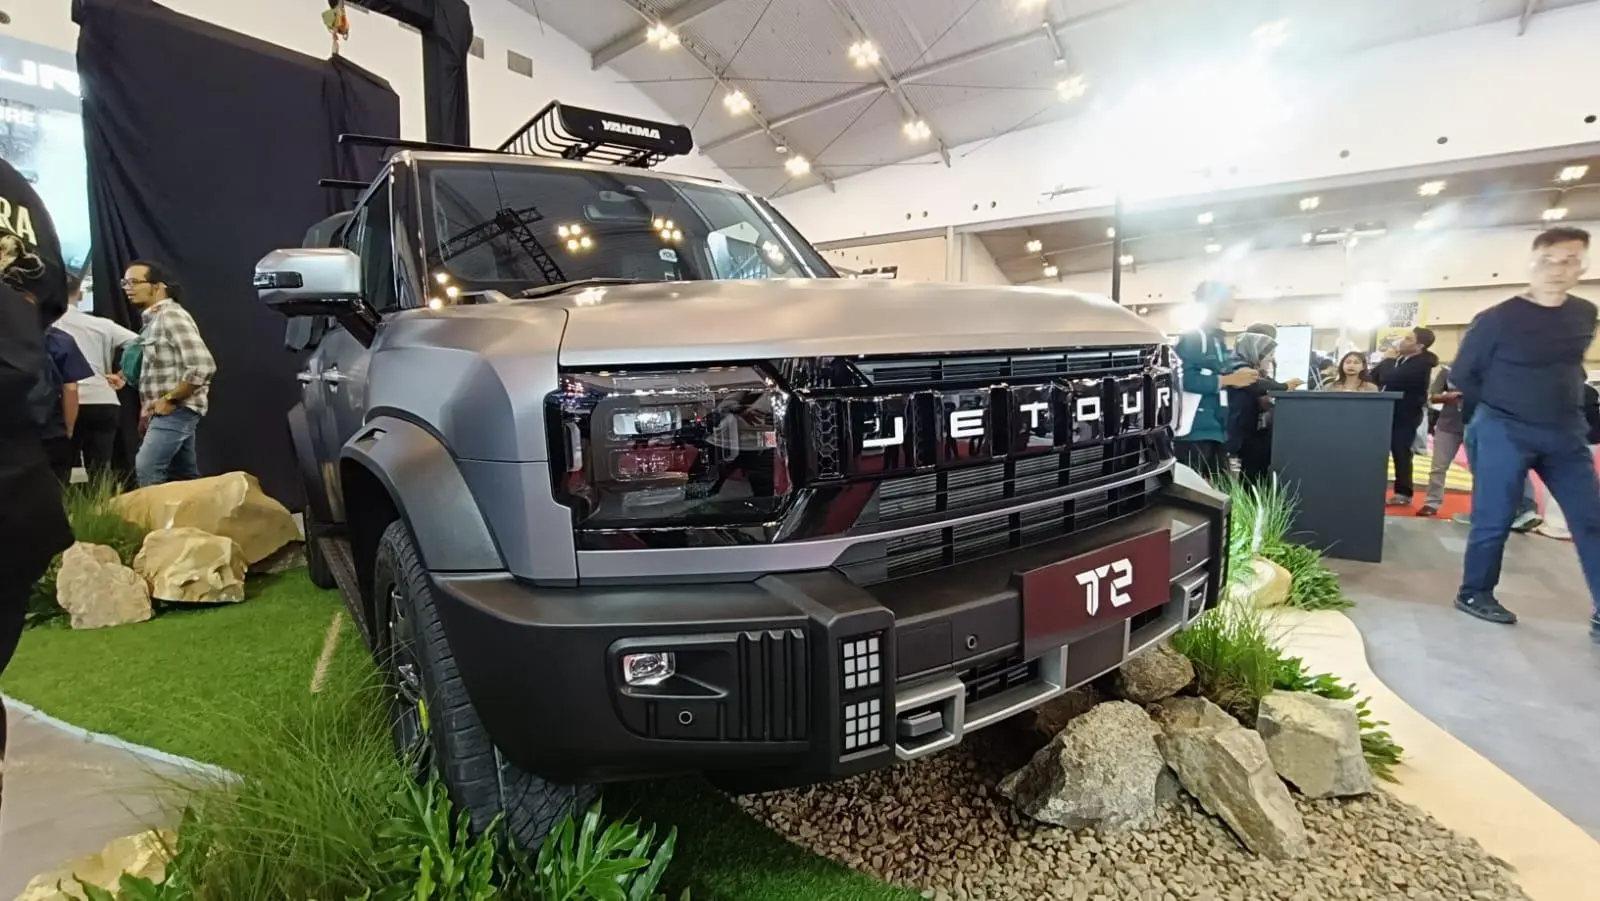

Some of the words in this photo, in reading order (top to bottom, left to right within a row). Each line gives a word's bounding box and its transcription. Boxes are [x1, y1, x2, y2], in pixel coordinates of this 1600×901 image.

[601, 119, 660, 139] YAKIMA
[863, 387, 1171, 448] JETOUR
[1075, 558, 1132, 616] T2
